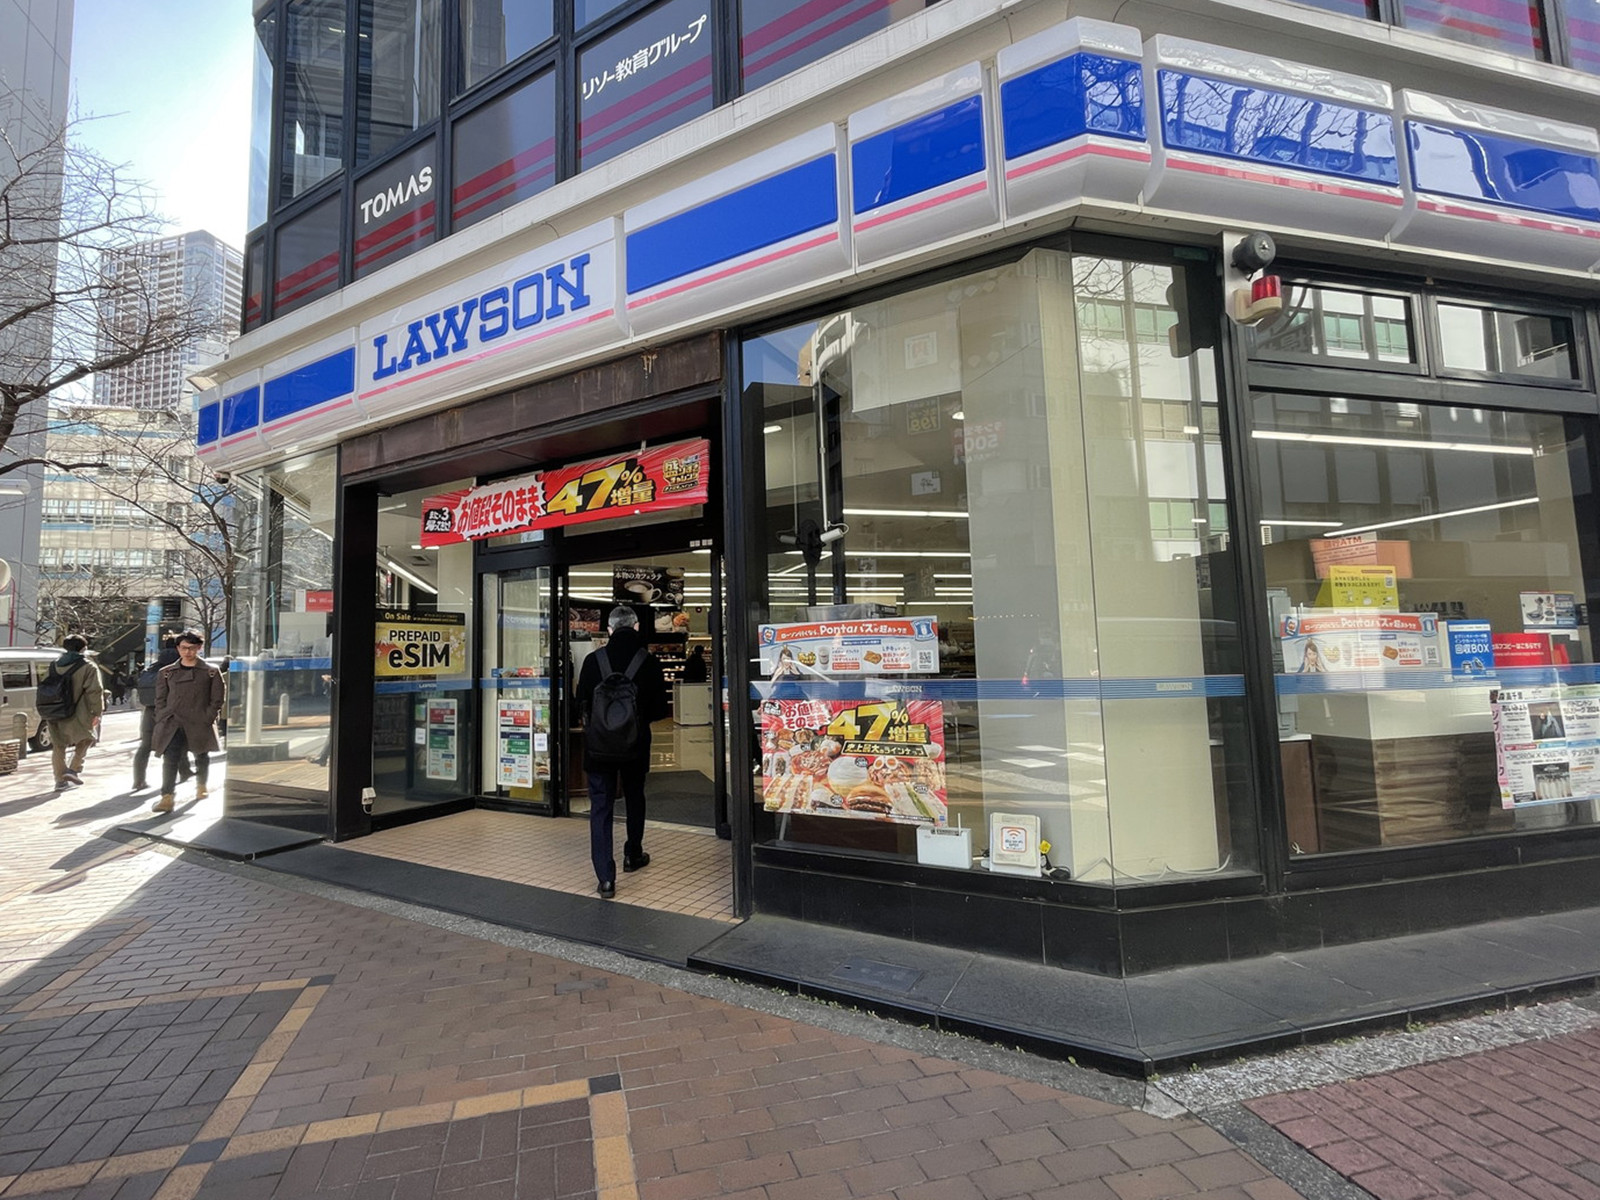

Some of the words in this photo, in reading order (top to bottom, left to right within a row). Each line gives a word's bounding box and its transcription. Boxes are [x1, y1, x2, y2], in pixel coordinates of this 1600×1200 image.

[583, 15, 707, 99] リソー教育グループ
[361, 166, 433, 224] TOMAS
[373, 253, 590, 380] LAWSON
[457, 485, 541, 534] お値段そのまま
[385, 612, 395, 620] On
[396, 612, 412, 621] Sale
[389, 630, 441, 642] PREPAID
[388, 643, 450, 668] eSIM
[1455, 643, 1490, 655] 回収BOX
[1492, 709, 1505, 776] ジブリパーク
